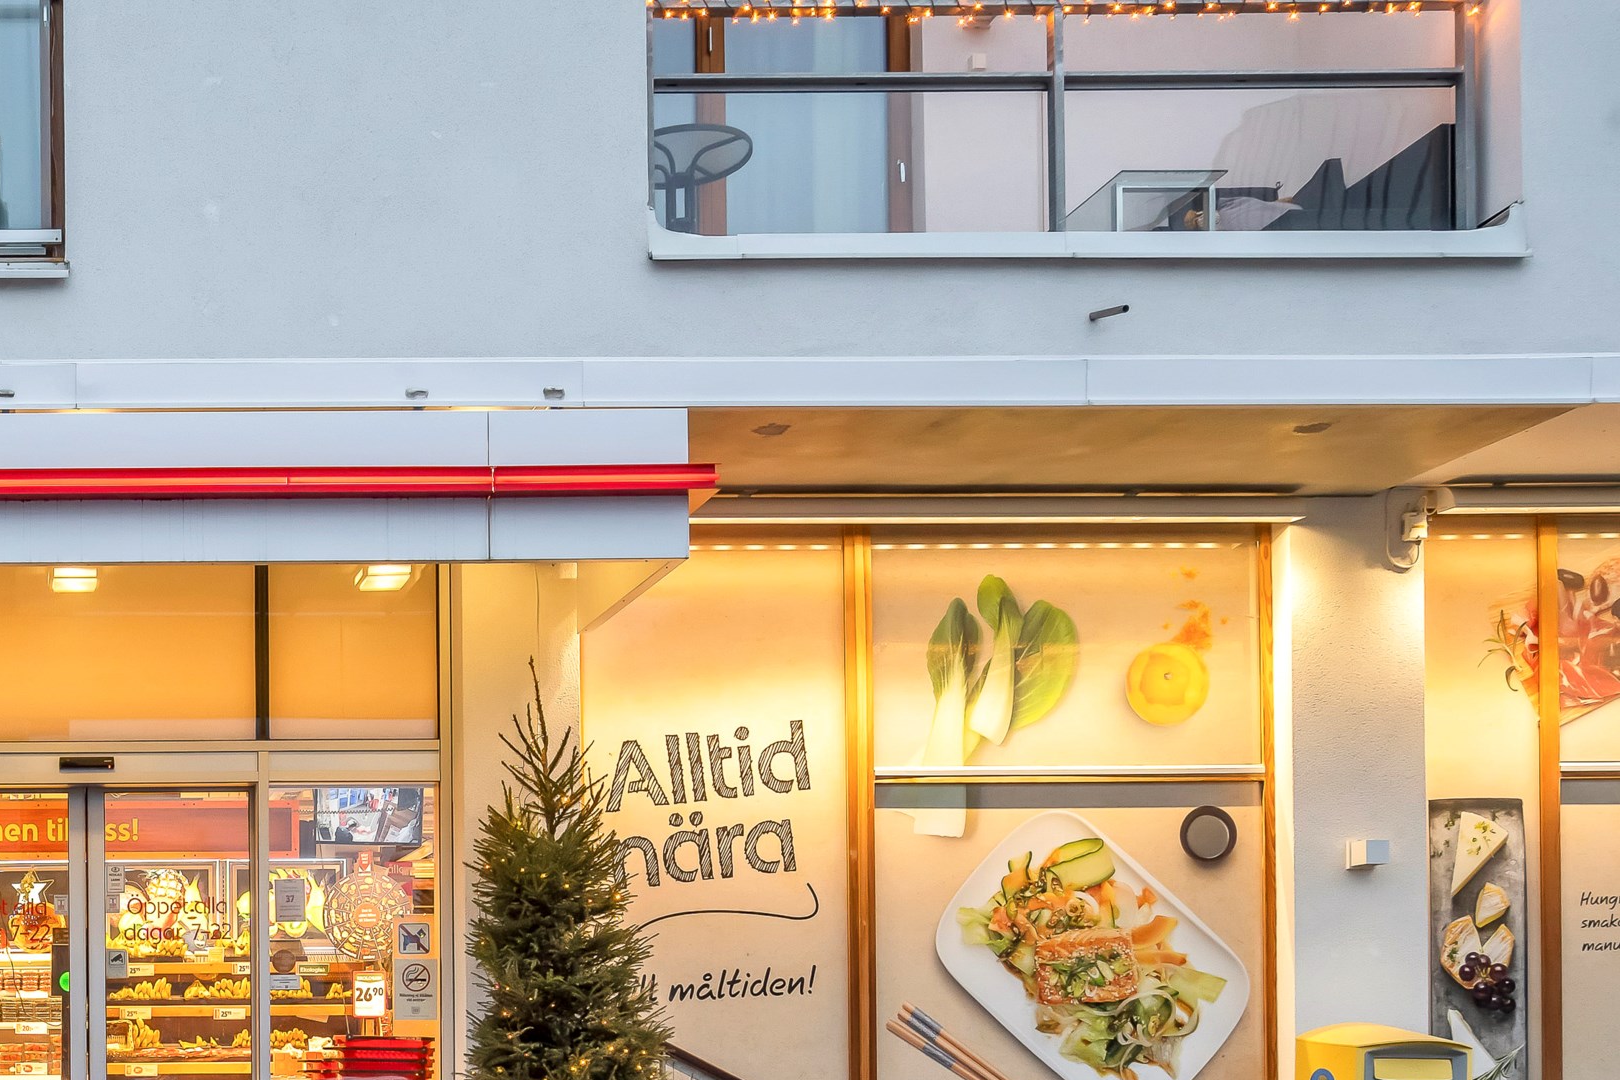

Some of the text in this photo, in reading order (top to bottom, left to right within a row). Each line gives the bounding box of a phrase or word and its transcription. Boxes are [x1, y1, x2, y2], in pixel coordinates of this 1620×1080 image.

[605, 719, 811, 813] Alltid
[47, 817, 69, 842] til
[105, 818, 139, 842] ss!
[612, 811, 797, 890] nära
[127, 893, 189, 920] Öppet
[285, 894, 295, 903] 37
[1579, 891, 1620, 910] Hung
[124, 923, 183, 945] dagar
[668, 964, 817, 1002] måltiden!
